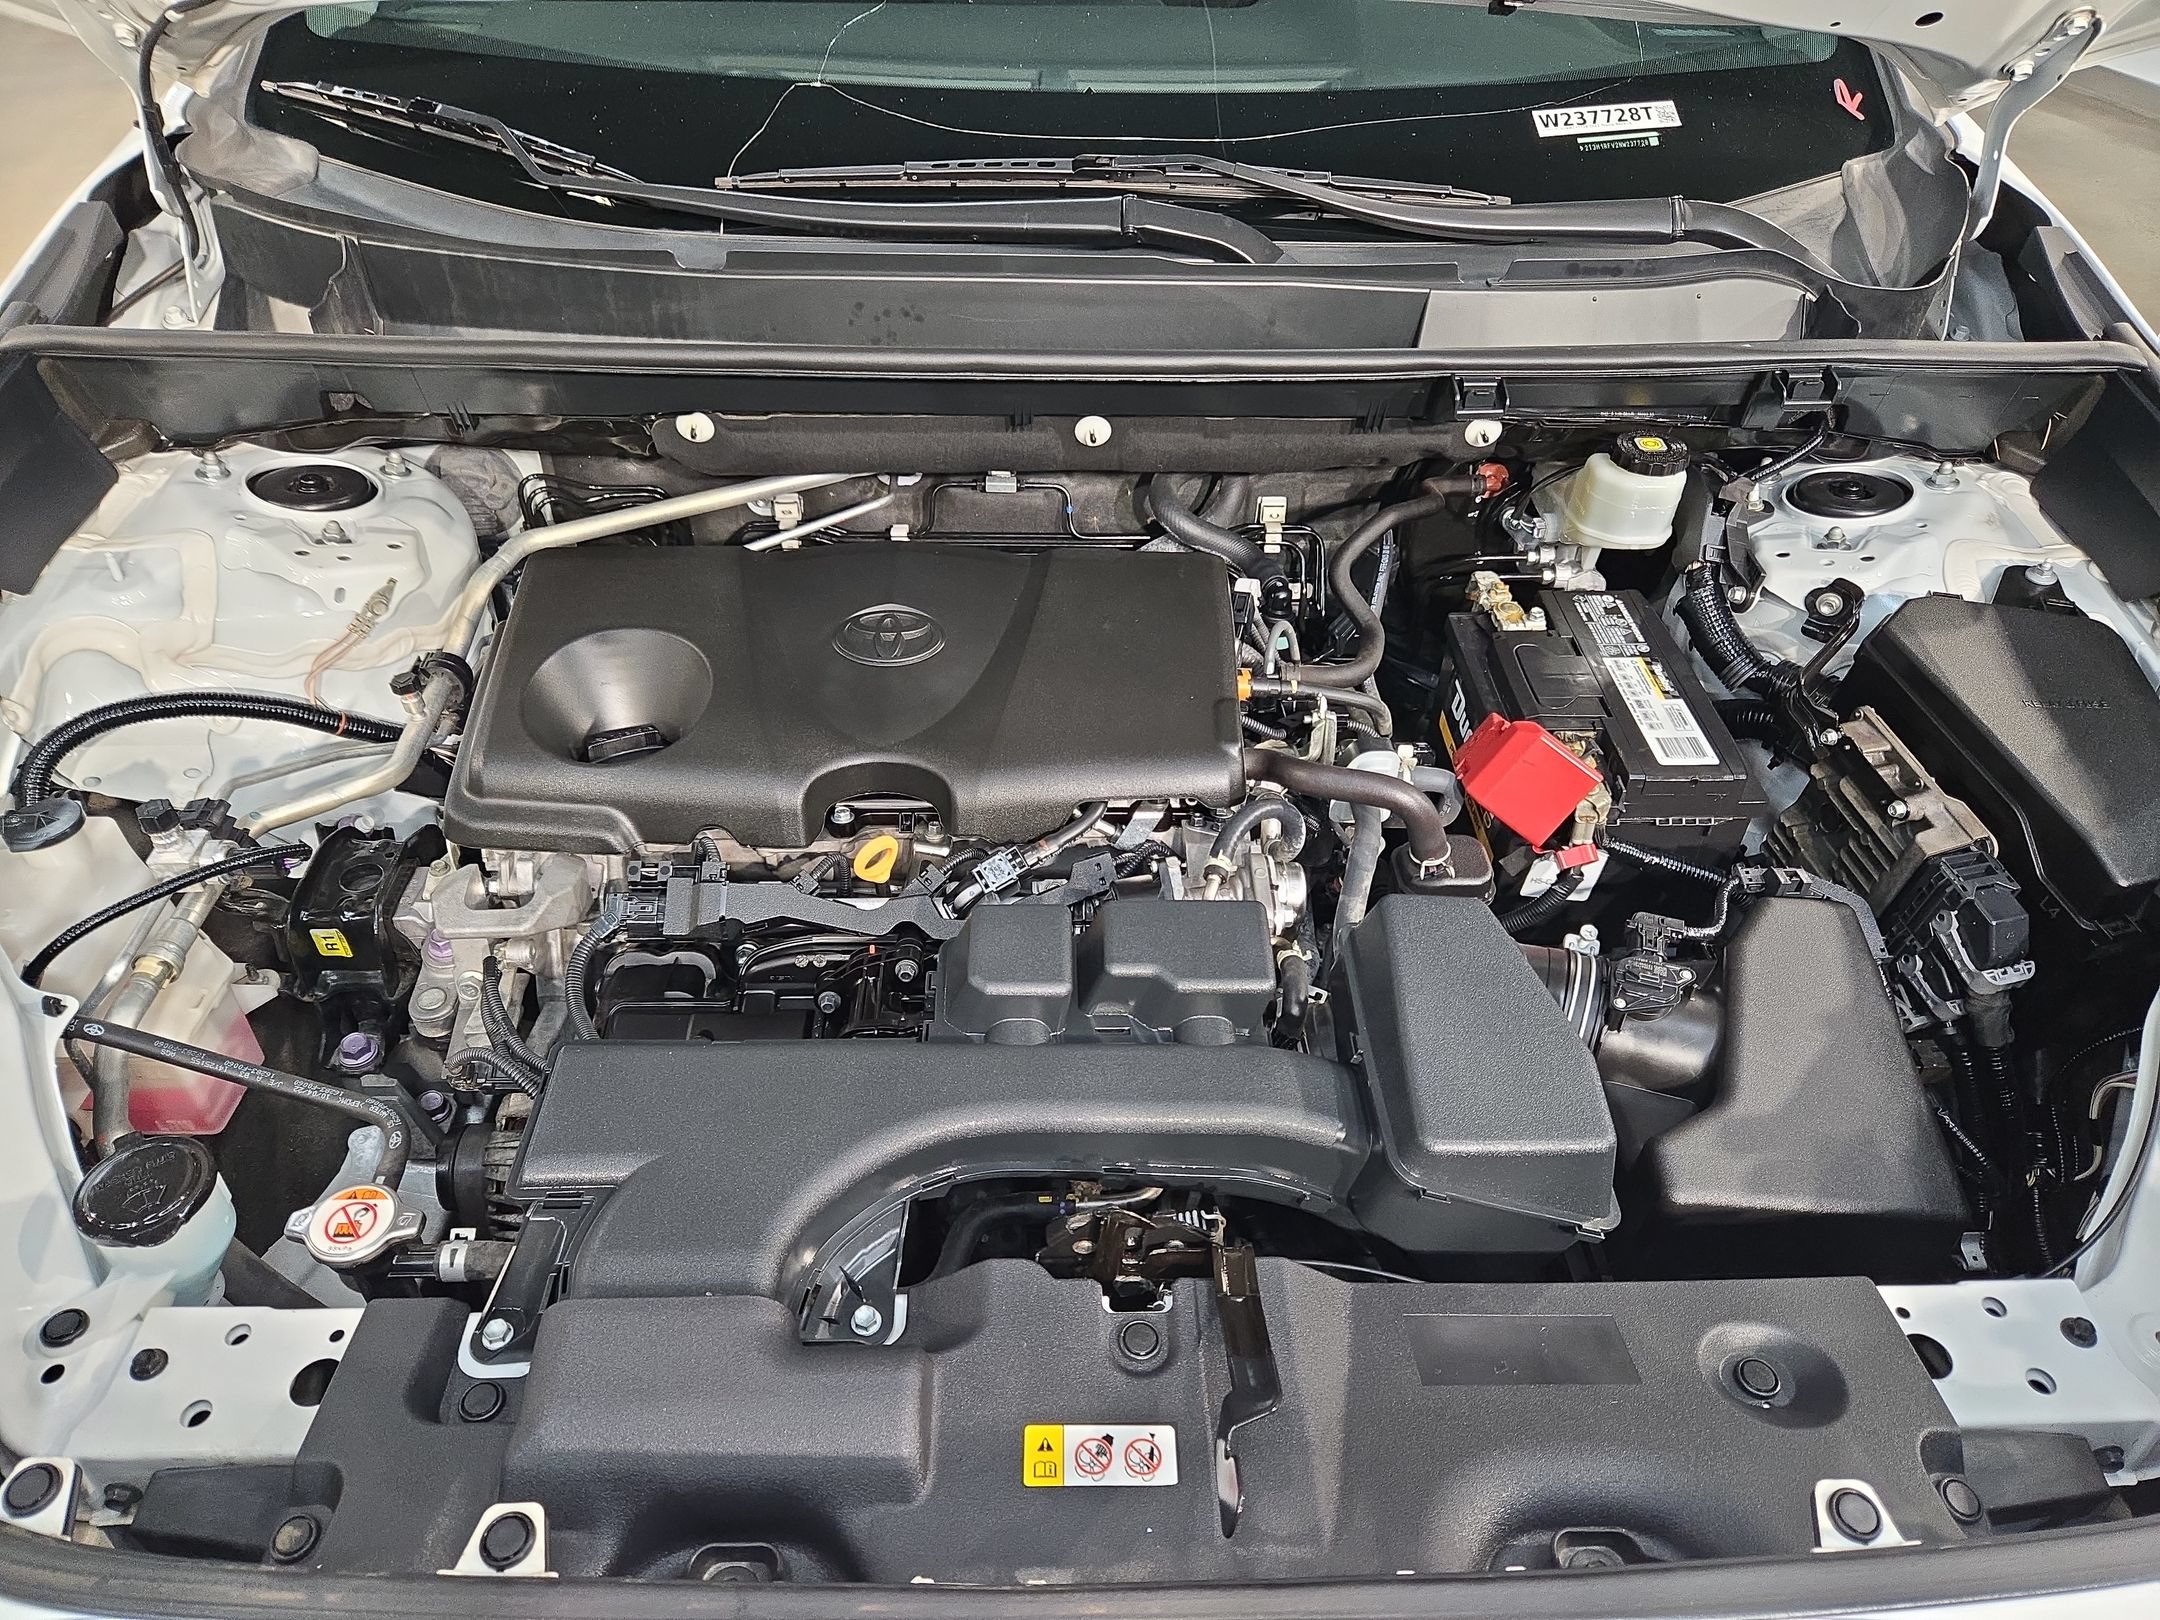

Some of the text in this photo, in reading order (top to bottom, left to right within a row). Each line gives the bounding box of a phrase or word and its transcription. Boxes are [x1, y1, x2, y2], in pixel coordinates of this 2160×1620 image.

[1538, 106, 1653, 128] W237728T
[320, 936, 340, 950] R1
[293, 1085, 331, 1101] 10/04/22
